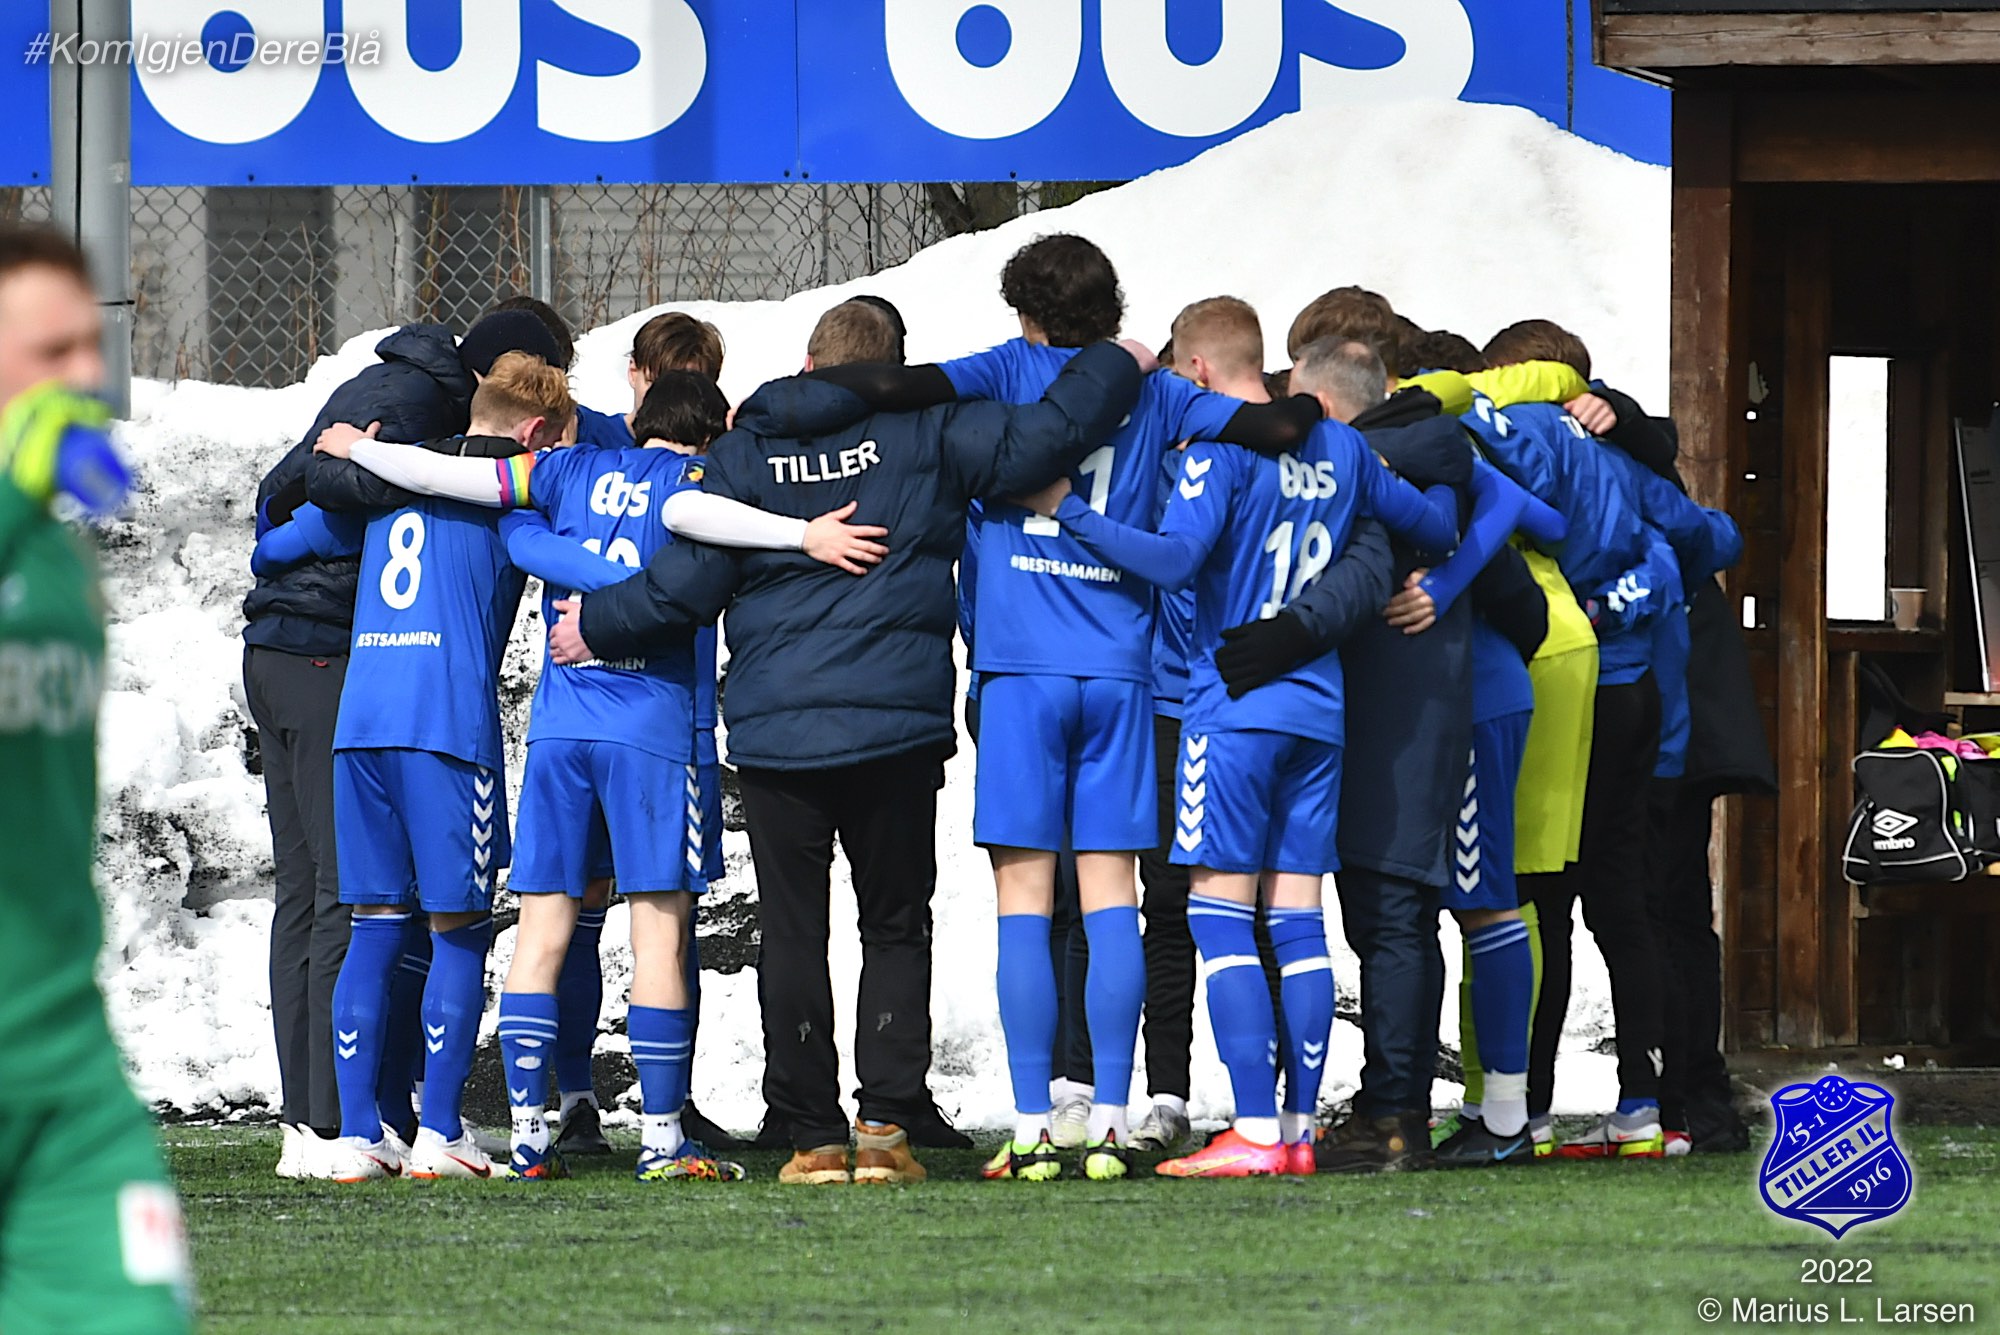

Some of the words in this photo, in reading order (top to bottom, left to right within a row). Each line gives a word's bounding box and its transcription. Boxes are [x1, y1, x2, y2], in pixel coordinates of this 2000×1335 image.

[767, 440, 880, 483] TILLER
[380, 512, 425, 610] 8
[1011, 554, 1121, 583] #BESTSAMMEN
[356, 631, 441, 649] ESTSAMMEN
